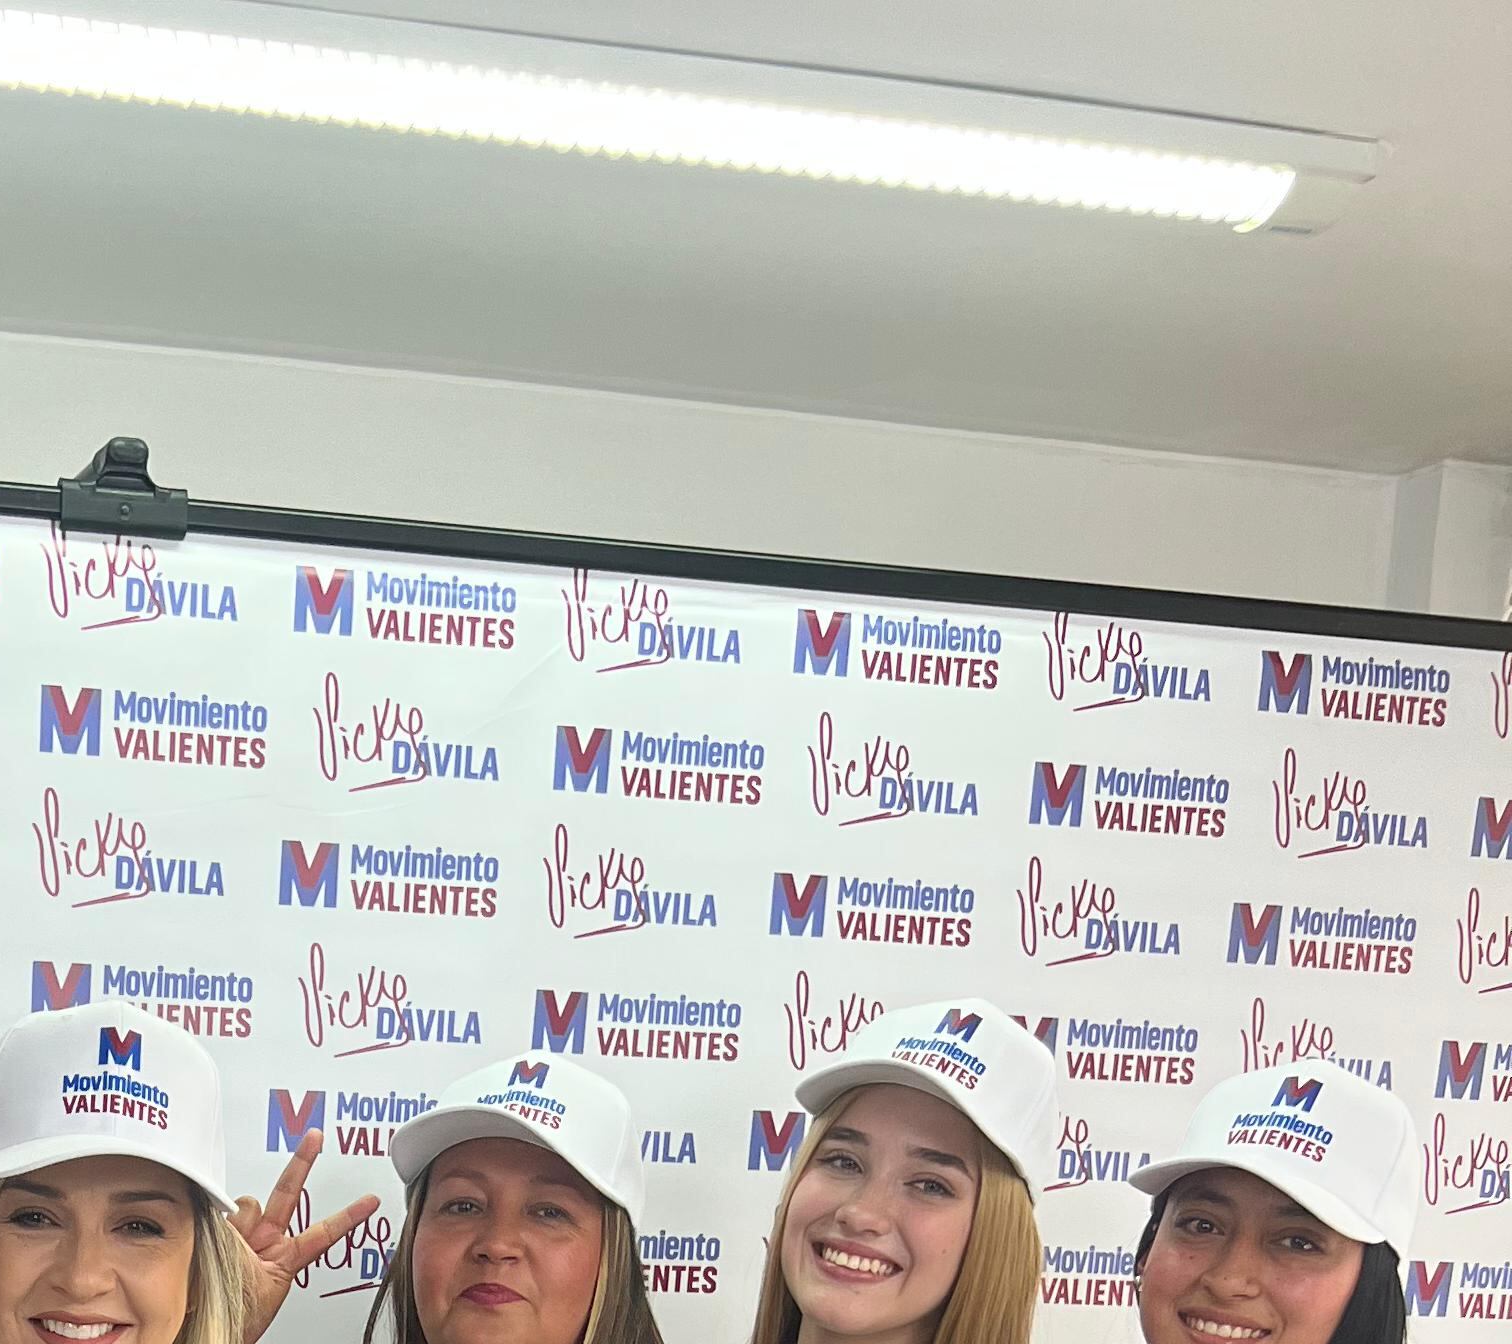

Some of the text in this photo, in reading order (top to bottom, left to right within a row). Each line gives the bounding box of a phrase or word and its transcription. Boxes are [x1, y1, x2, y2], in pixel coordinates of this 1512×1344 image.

[125, 571, 238, 622] DÁVILA
[366, 570, 517, 614] Movimiento
[366, 607, 515, 650] VALIENTES
[637, 613, 741, 665] DÁVILA
[861, 613, 1002, 655] Movimiento
[861, 650, 999, 690] VALIENTES
[1112, 656, 1209, 701] DÁVILA
[1323, 661, 1449, 693] Movimiento
[113, 690, 268, 733] Movimiento
[1321, 687, 1448, 728] VALIENTES
[114, 727, 266, 769] VALIENTES
[391, 735, 499, 781] DÁVILA
[621, 730, 765, 771] Movimiento
[621, 767, 762, 806] VALIENTES
[879, 771, 978, 817] DÁVILA
[1095, 768, 1228, 804] Movimiento
[1095, 800, 1226, 839] VALIENTES
[1336, 804, 1426, 847] DÁVILA
[115, 851, 224, 896] DÁVILA
[350, 846, 499, 882] Movimiento
[350, 879, 497, 919] VALIENTES
[614, 883, 717, 928] DÁVILA
[837, 879, 975, 914] Movimiento
[837, 911, 973, 948] VALIENTES
[1084, 912, 1179, 955] DÁVILA
[1290, 911, 1416, 943] Movimiento
[1289, 938, 1414, 975] VALIENTES
[103, 966, 253, 1004] Movimiento
[375, 1000, 481, 1044] DÁVILA
[597, 993, 742, 1028] Movimiento
[596, 1026, 740, 1063] VALIENTES
[1066, 1022, 1197, 1052] Movimiento
[1066, 1050, 1196, 1086] VALIENTES
[61, 1071, 169, 1109] Movimiento
[62, 1093, 168, 1131] VALIENTES
[1233, 1112, 1333, 1145] Movimiento
[1229, 1129, 1327, 1163] VALIENTES
[641, 1236, 721, 1262] miento
[1047, 1248, 1135, 1275] Movimie
[1041, 1275, 1136, 1307] VALIENT
